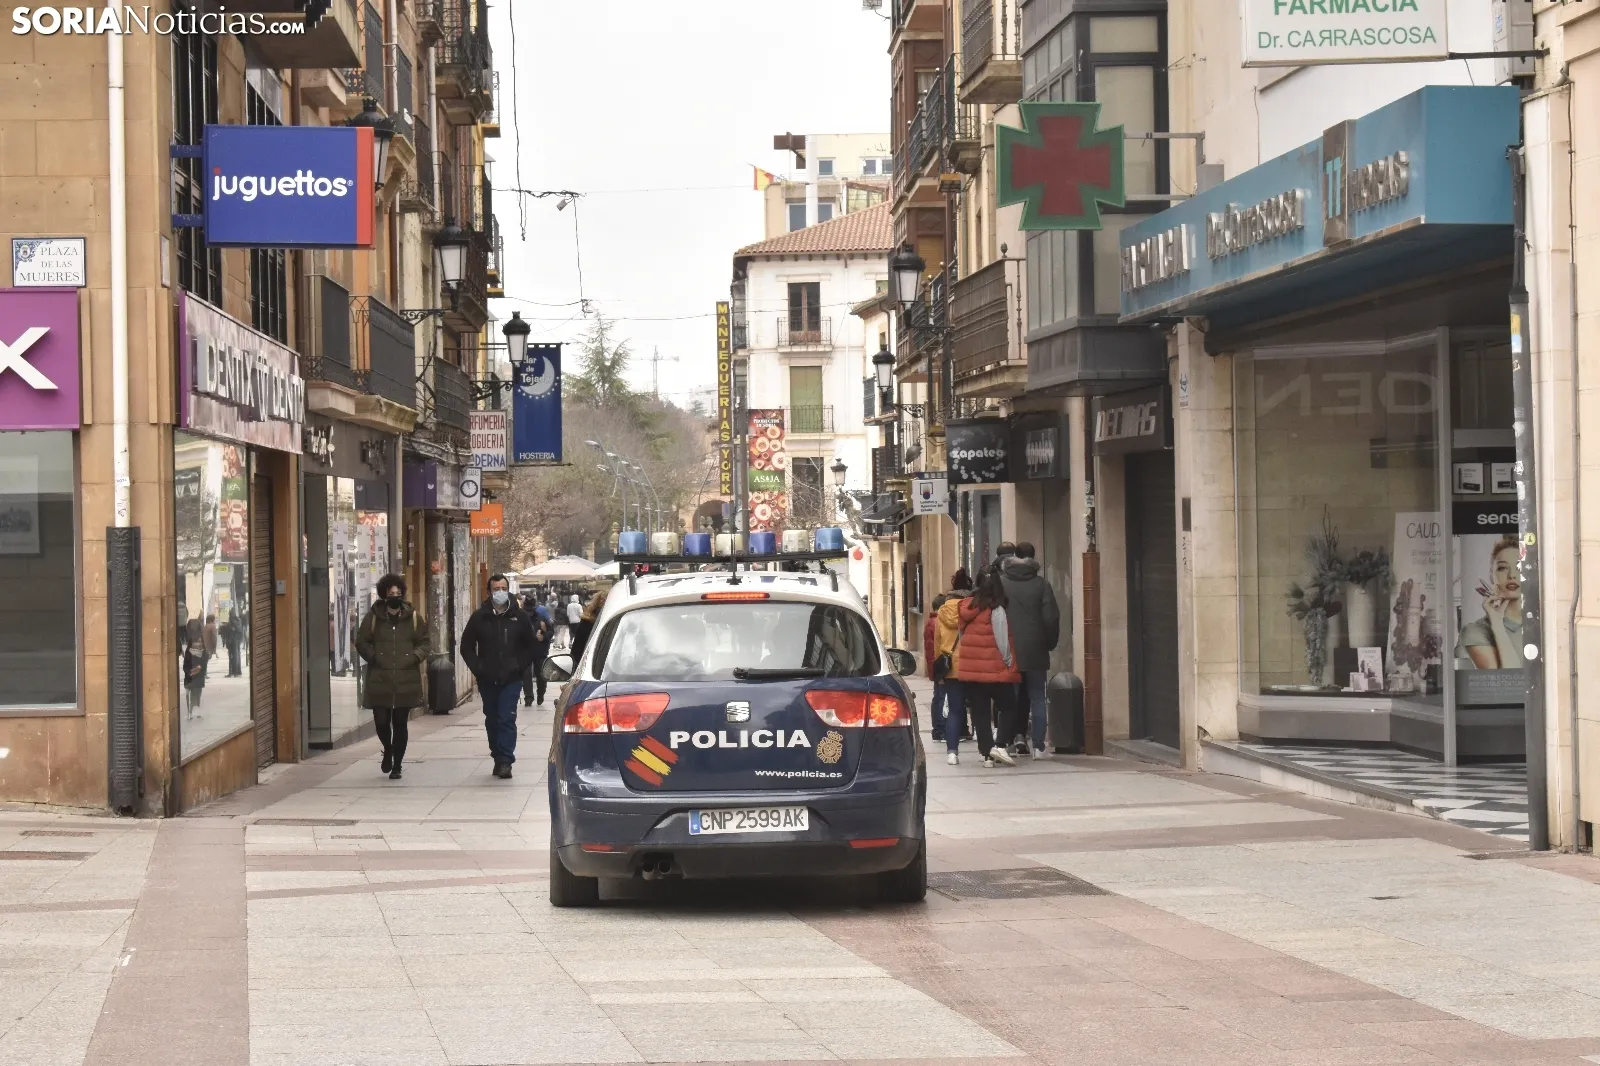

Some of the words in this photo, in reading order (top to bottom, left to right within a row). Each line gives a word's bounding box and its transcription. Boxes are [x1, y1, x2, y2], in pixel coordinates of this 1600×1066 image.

[1274, 0, 1418, 15] FARMACIA
[1258, 31, 1283, 49] Dr.
[212, 167, 348, 202] juguettos
[40, 246, 79, 256] PLAZA
[41, 260, 54, 268] DE
[56, 260, 73, 268] LAS
[19, 271, 80, 282] MUJERES
[470, 433, 505, 449] OGUERIA
[473, 453, 506, 468] DERNA
[519, 452, 556, 460] HOSTERIA
[721, 449, 731, 494] YORK
[471, 527, 500, 535] orange
[669, 729, 812, 749] POLICIA
[754, 769, 843, 779] www.policia.es
